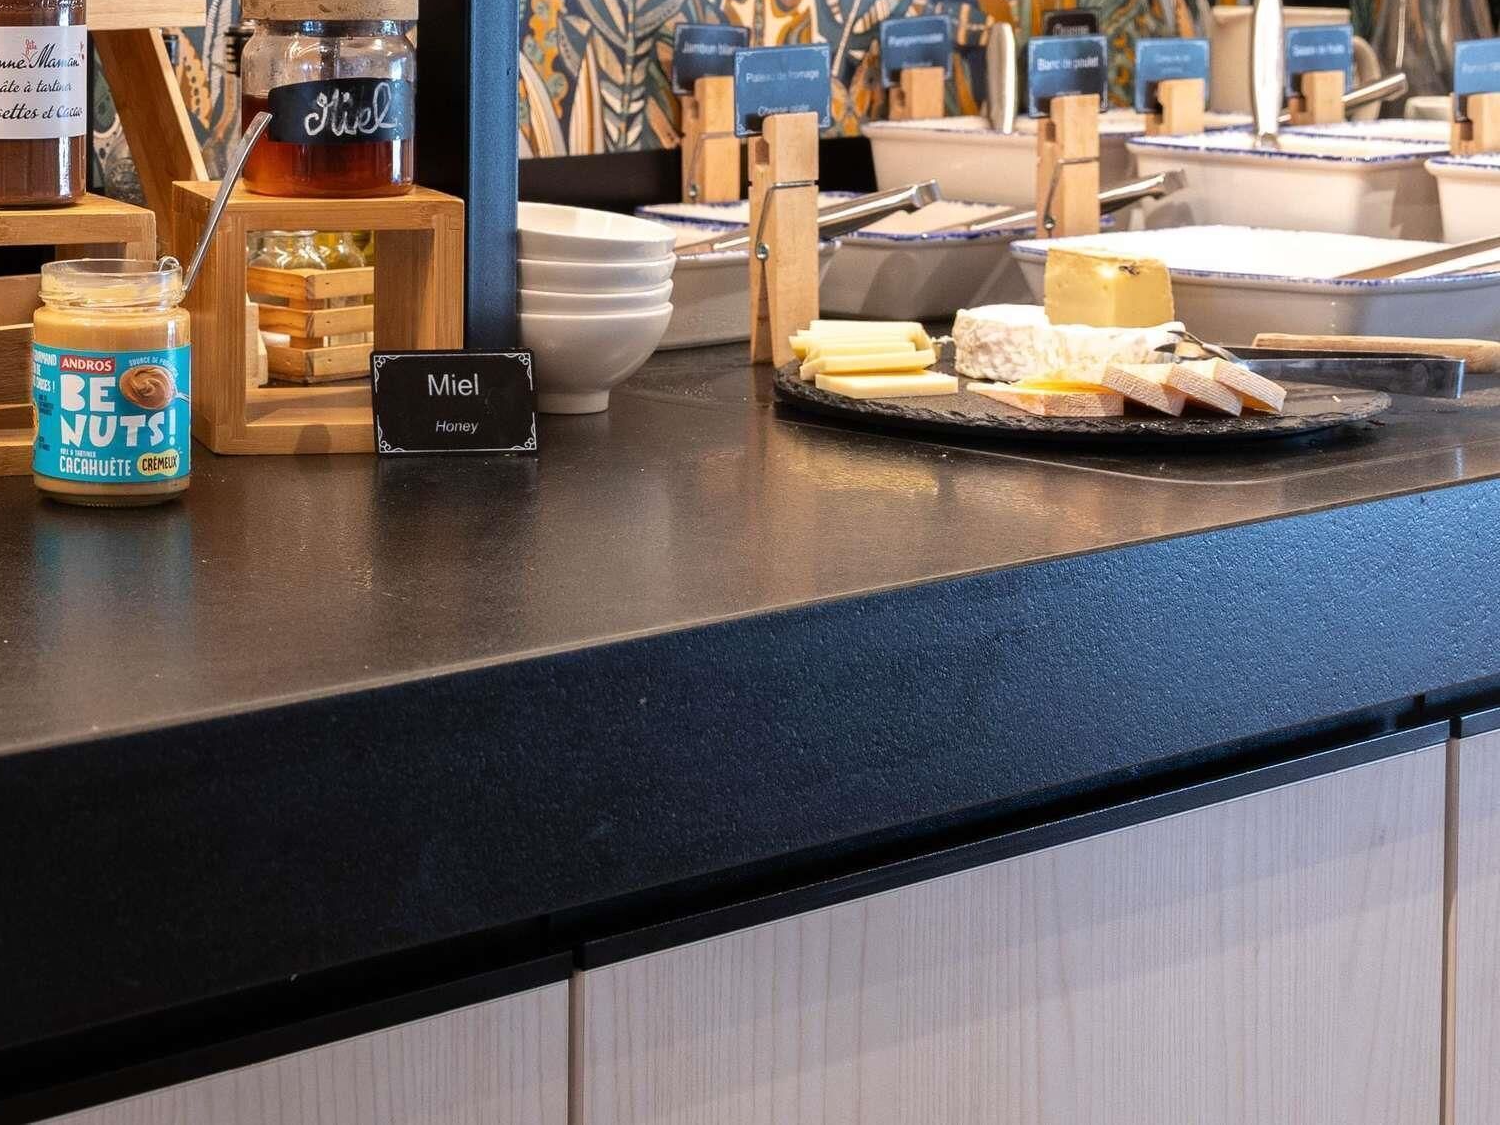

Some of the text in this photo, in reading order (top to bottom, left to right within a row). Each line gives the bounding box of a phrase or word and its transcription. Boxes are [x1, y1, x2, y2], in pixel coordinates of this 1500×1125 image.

[29, 42, 80, 68] Maman
[23, 81, 32, 93] à
[35, 79, 72, 93] tartiner
[42, 106, 54, 119] et
[304, 81, 398, 137] Miel
[62, 357, 113, 373] ANDROS
[60, 374, 116, 412] BE
[427, 373, 479, 396] Miel
[60, 408, 176, 448] NUTS!
[435, 420, 480, 435] Honey
[59, 455, 132, 477] CACAHUÈTE
